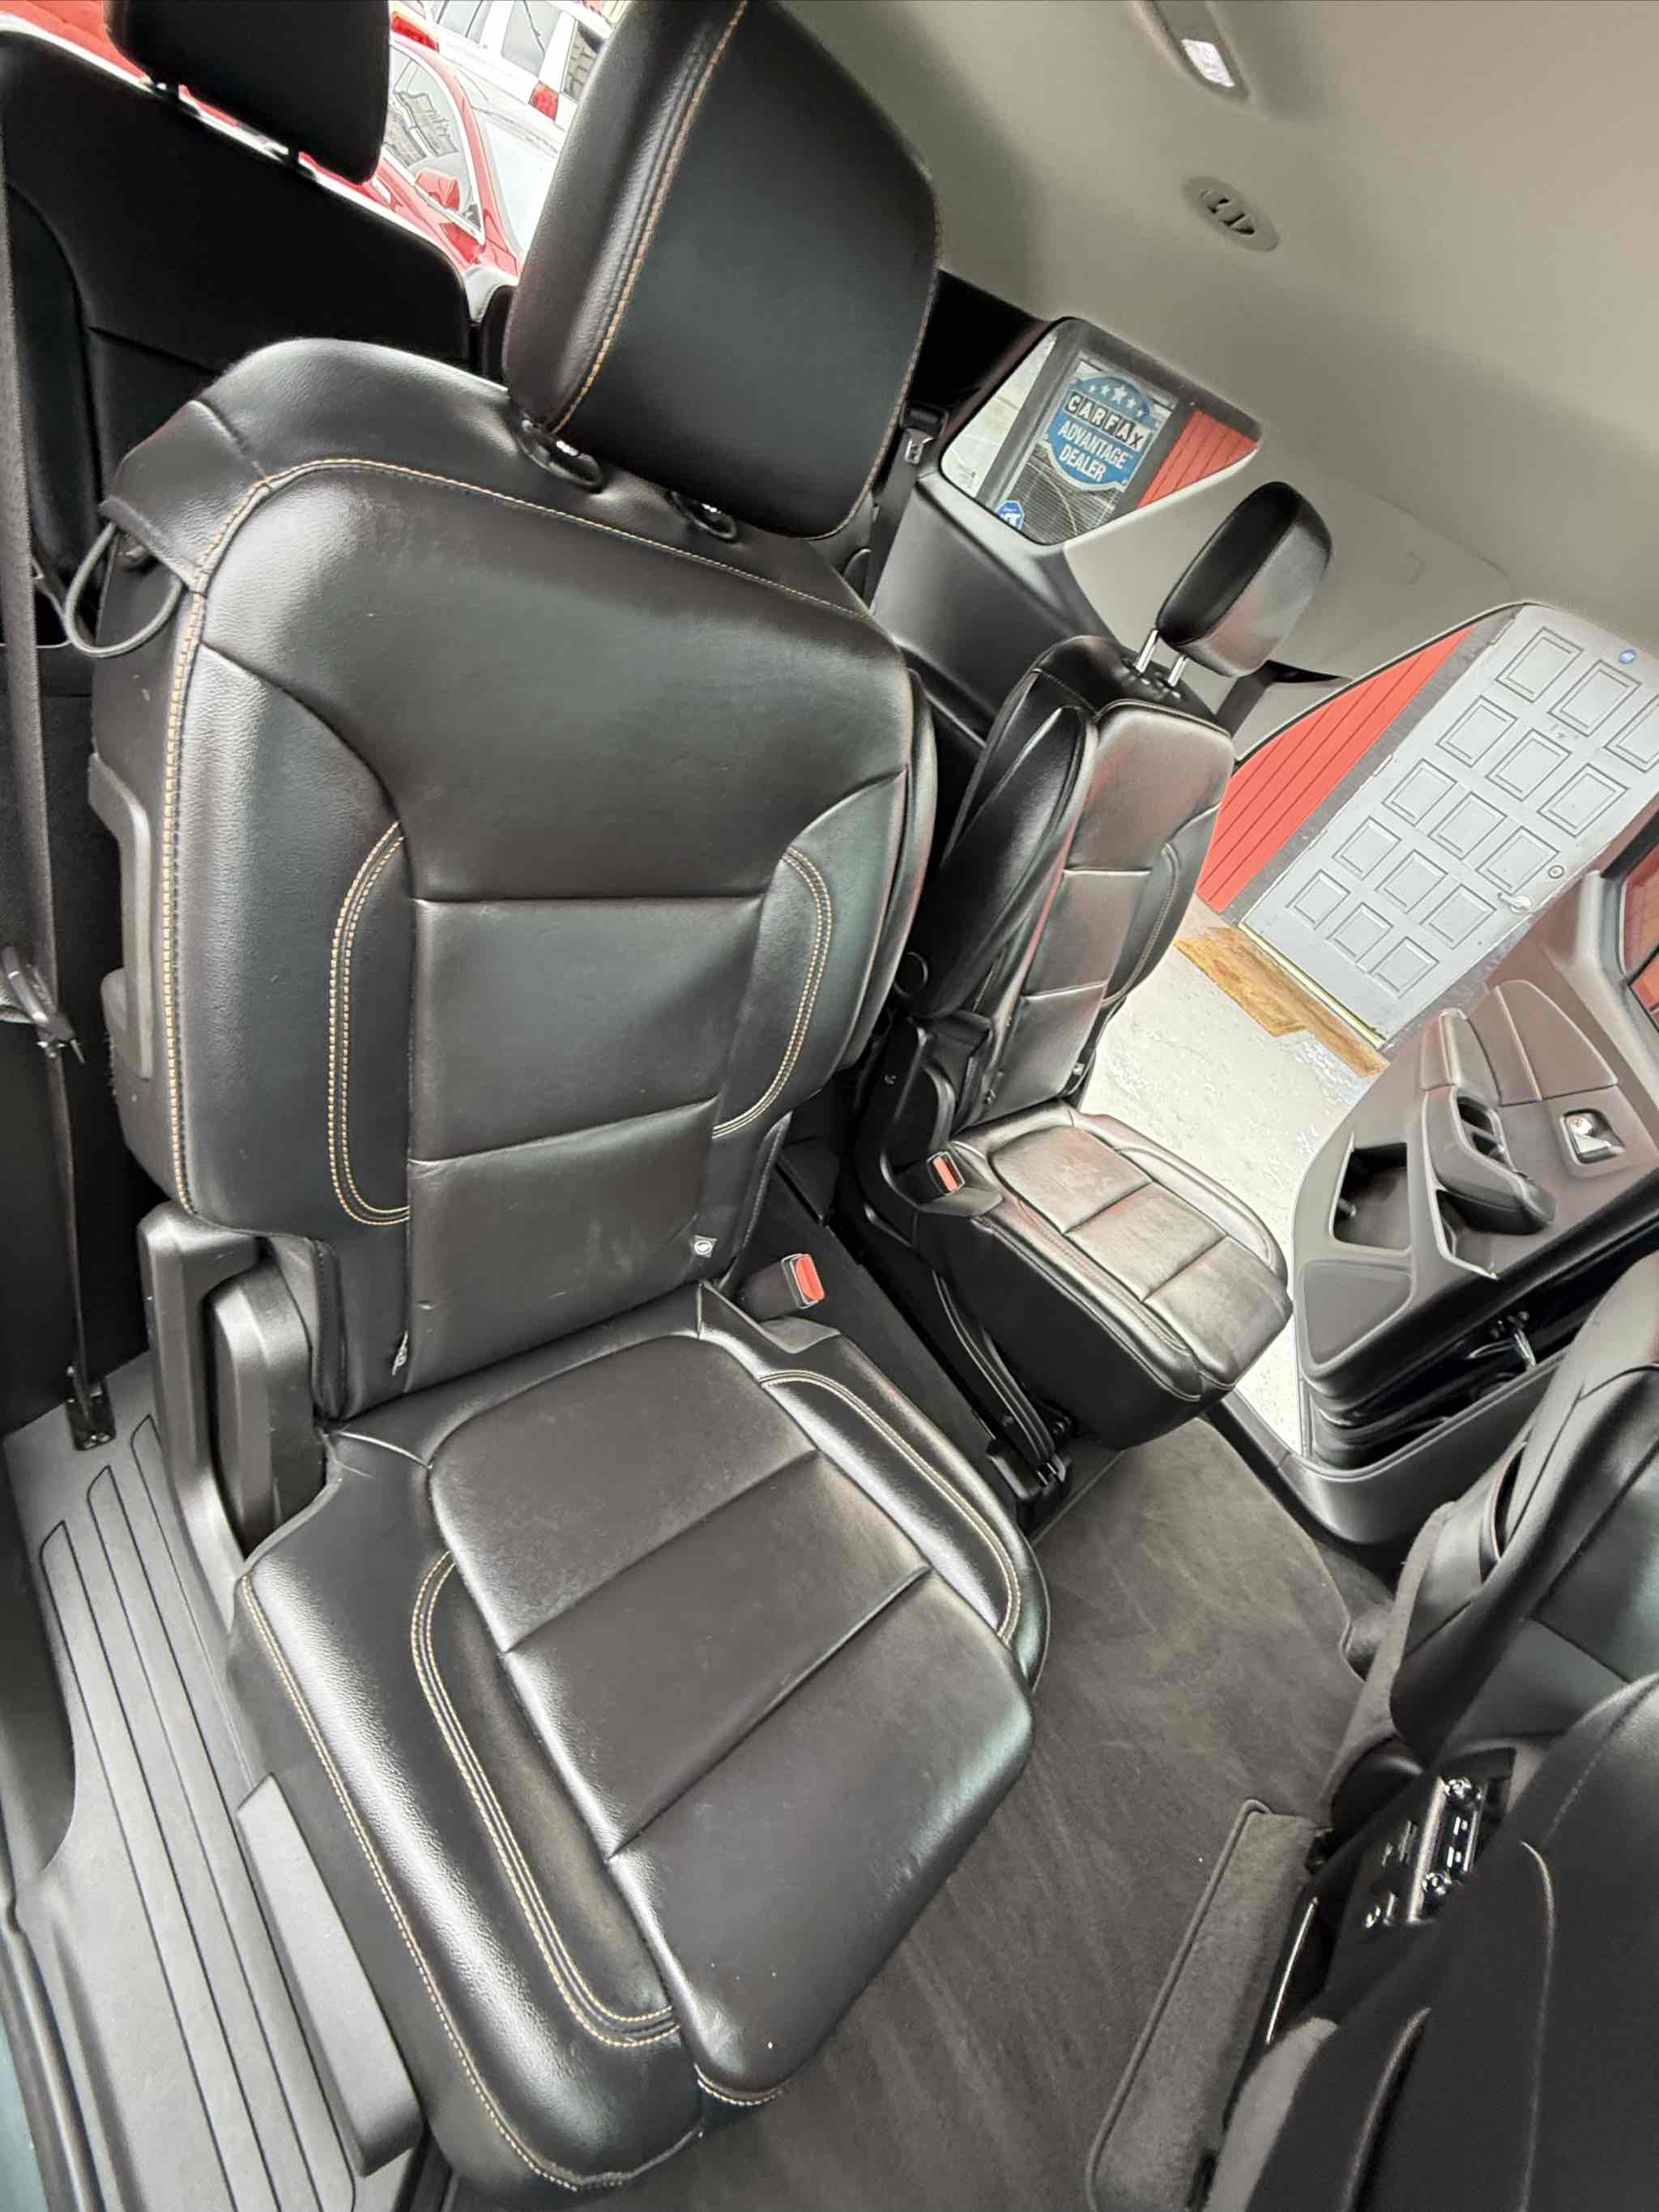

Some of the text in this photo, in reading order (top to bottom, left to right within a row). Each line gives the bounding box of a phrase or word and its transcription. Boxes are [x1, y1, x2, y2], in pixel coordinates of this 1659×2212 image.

[1057, 420, 1128, 470] ADVANTAGE
[1067, 394, 1145, 450] CARFAX
[1059, 444, 1107, 482] DEALER
